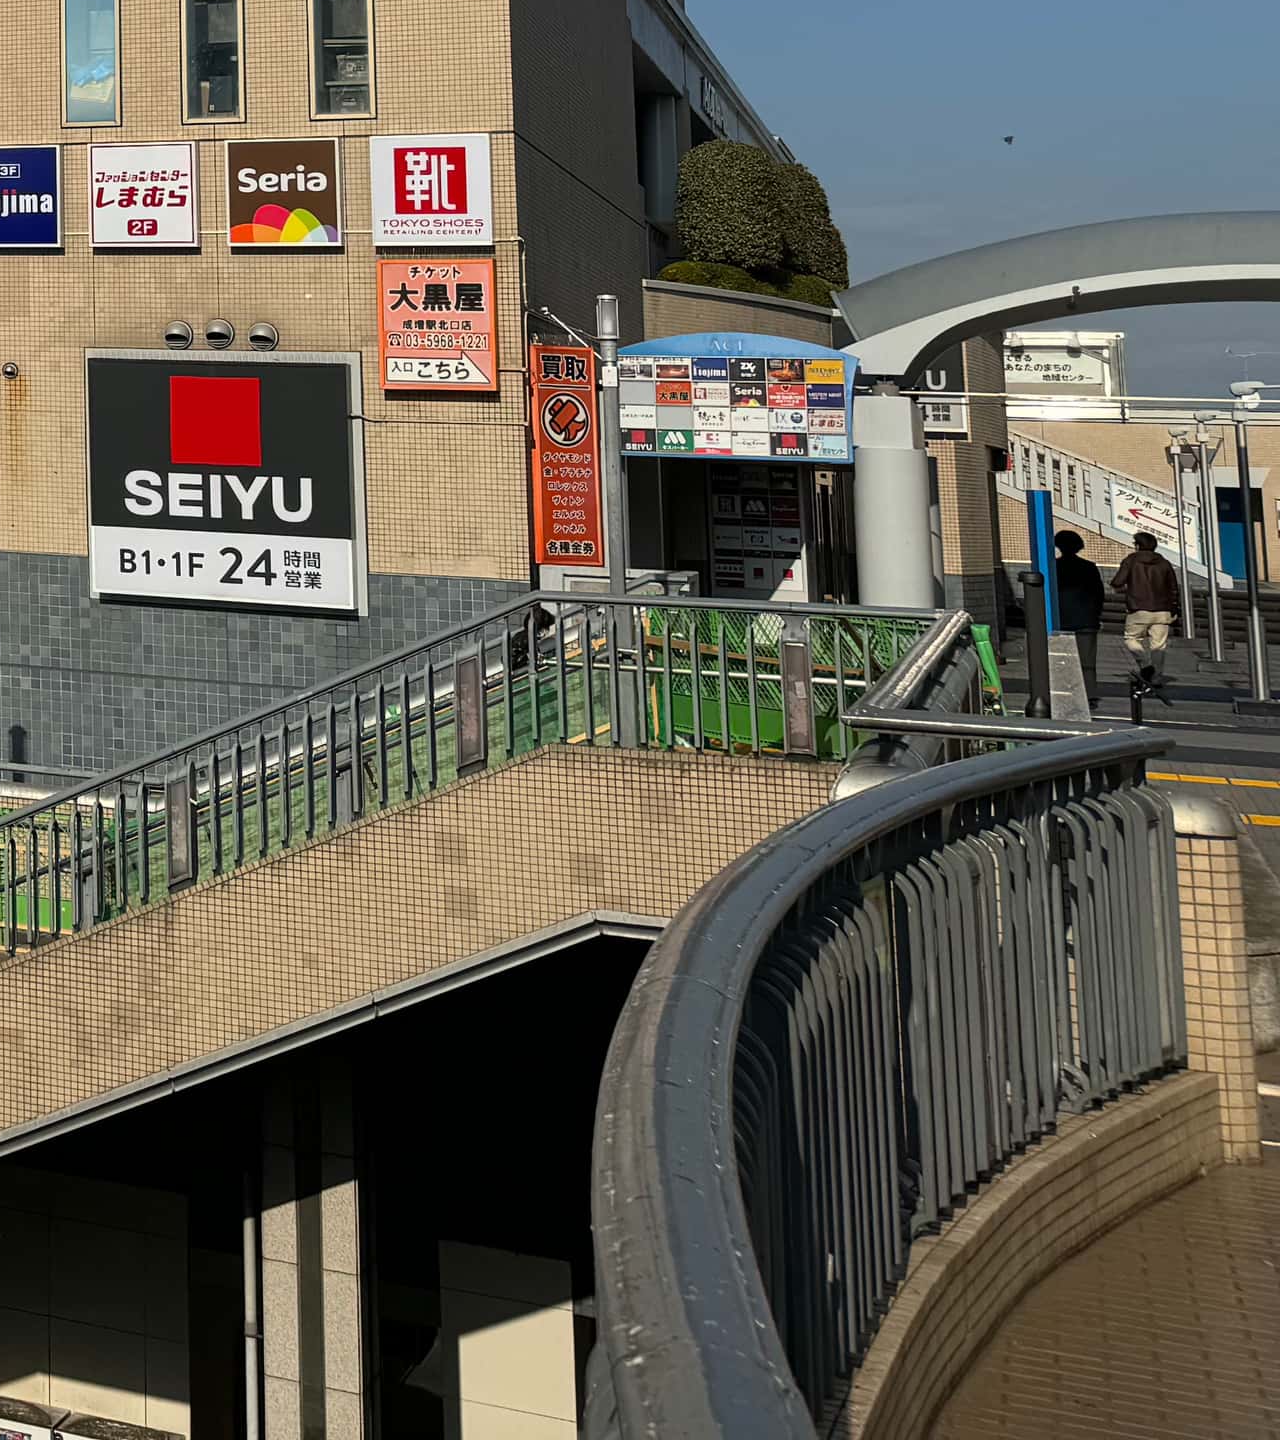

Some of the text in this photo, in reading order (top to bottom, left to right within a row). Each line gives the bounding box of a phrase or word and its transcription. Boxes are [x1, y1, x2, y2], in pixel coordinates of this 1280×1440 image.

[95, 169, 189, 184] ファッションセンター
[237, 166, 328, 193] Seria
[404, 151, 456, 211] 靴
[95, 186, 189, 210] しまむら
[131, 219, 154, 235] 2F
[380, 218, 485, 228] TOKYO SHOES
[408, 265, 462, 281] チケット
[388, 282, 485, 313] 大黒屋
[402, 318, 472, 331] 成増駅北口店
[404, 332, 488, 350] 03-5968-1221
[391, 360, 471, 381] 入口 こちら
[541, 353, 588, 381] 買取
[543, 452, 591, 463] ダイヤモンド
[547, 481, 589, 492] ロレックス
[123, 469, 313, 523] SEIYU
[552, 509, 585, 520] エルメス
[553, 523, 586, 534] シャネル
[547, 541, 595, 556] 各種金券
[219, 547, 277, 586] 24
[283, 550, 321, 570] 時間
[283, 570, 323, 590] 営業
